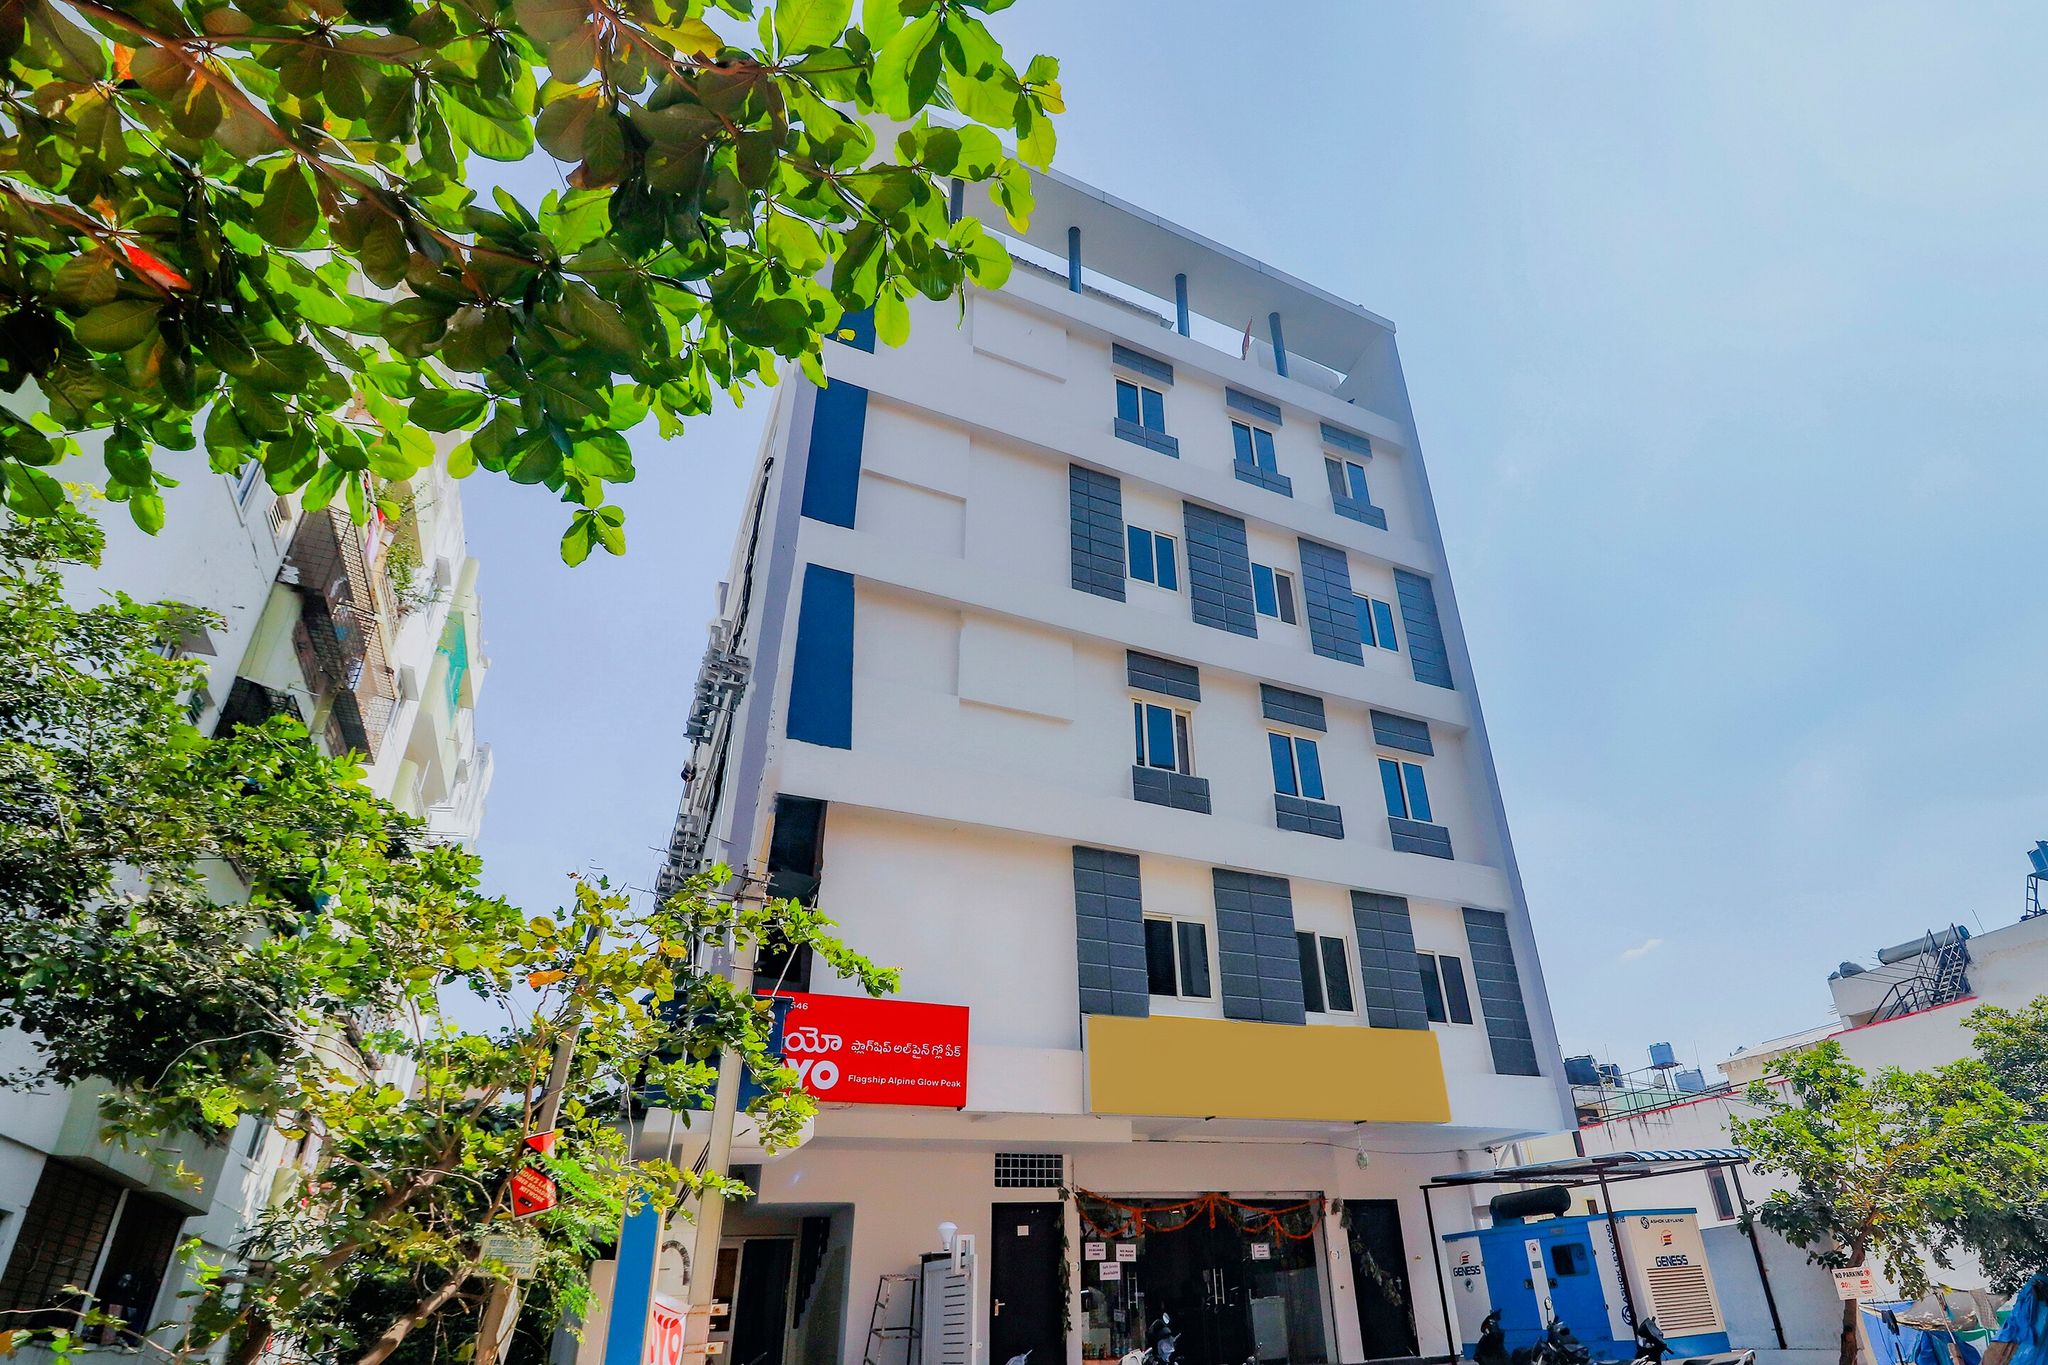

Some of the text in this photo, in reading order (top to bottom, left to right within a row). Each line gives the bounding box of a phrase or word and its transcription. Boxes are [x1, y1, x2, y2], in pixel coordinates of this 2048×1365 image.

[783, 1058, 840, 1090] YO
[848, 1074, 961, 1087] Flagship Alpine Glow Peak
[1843, 1270, 1864, 1278] PARKING
